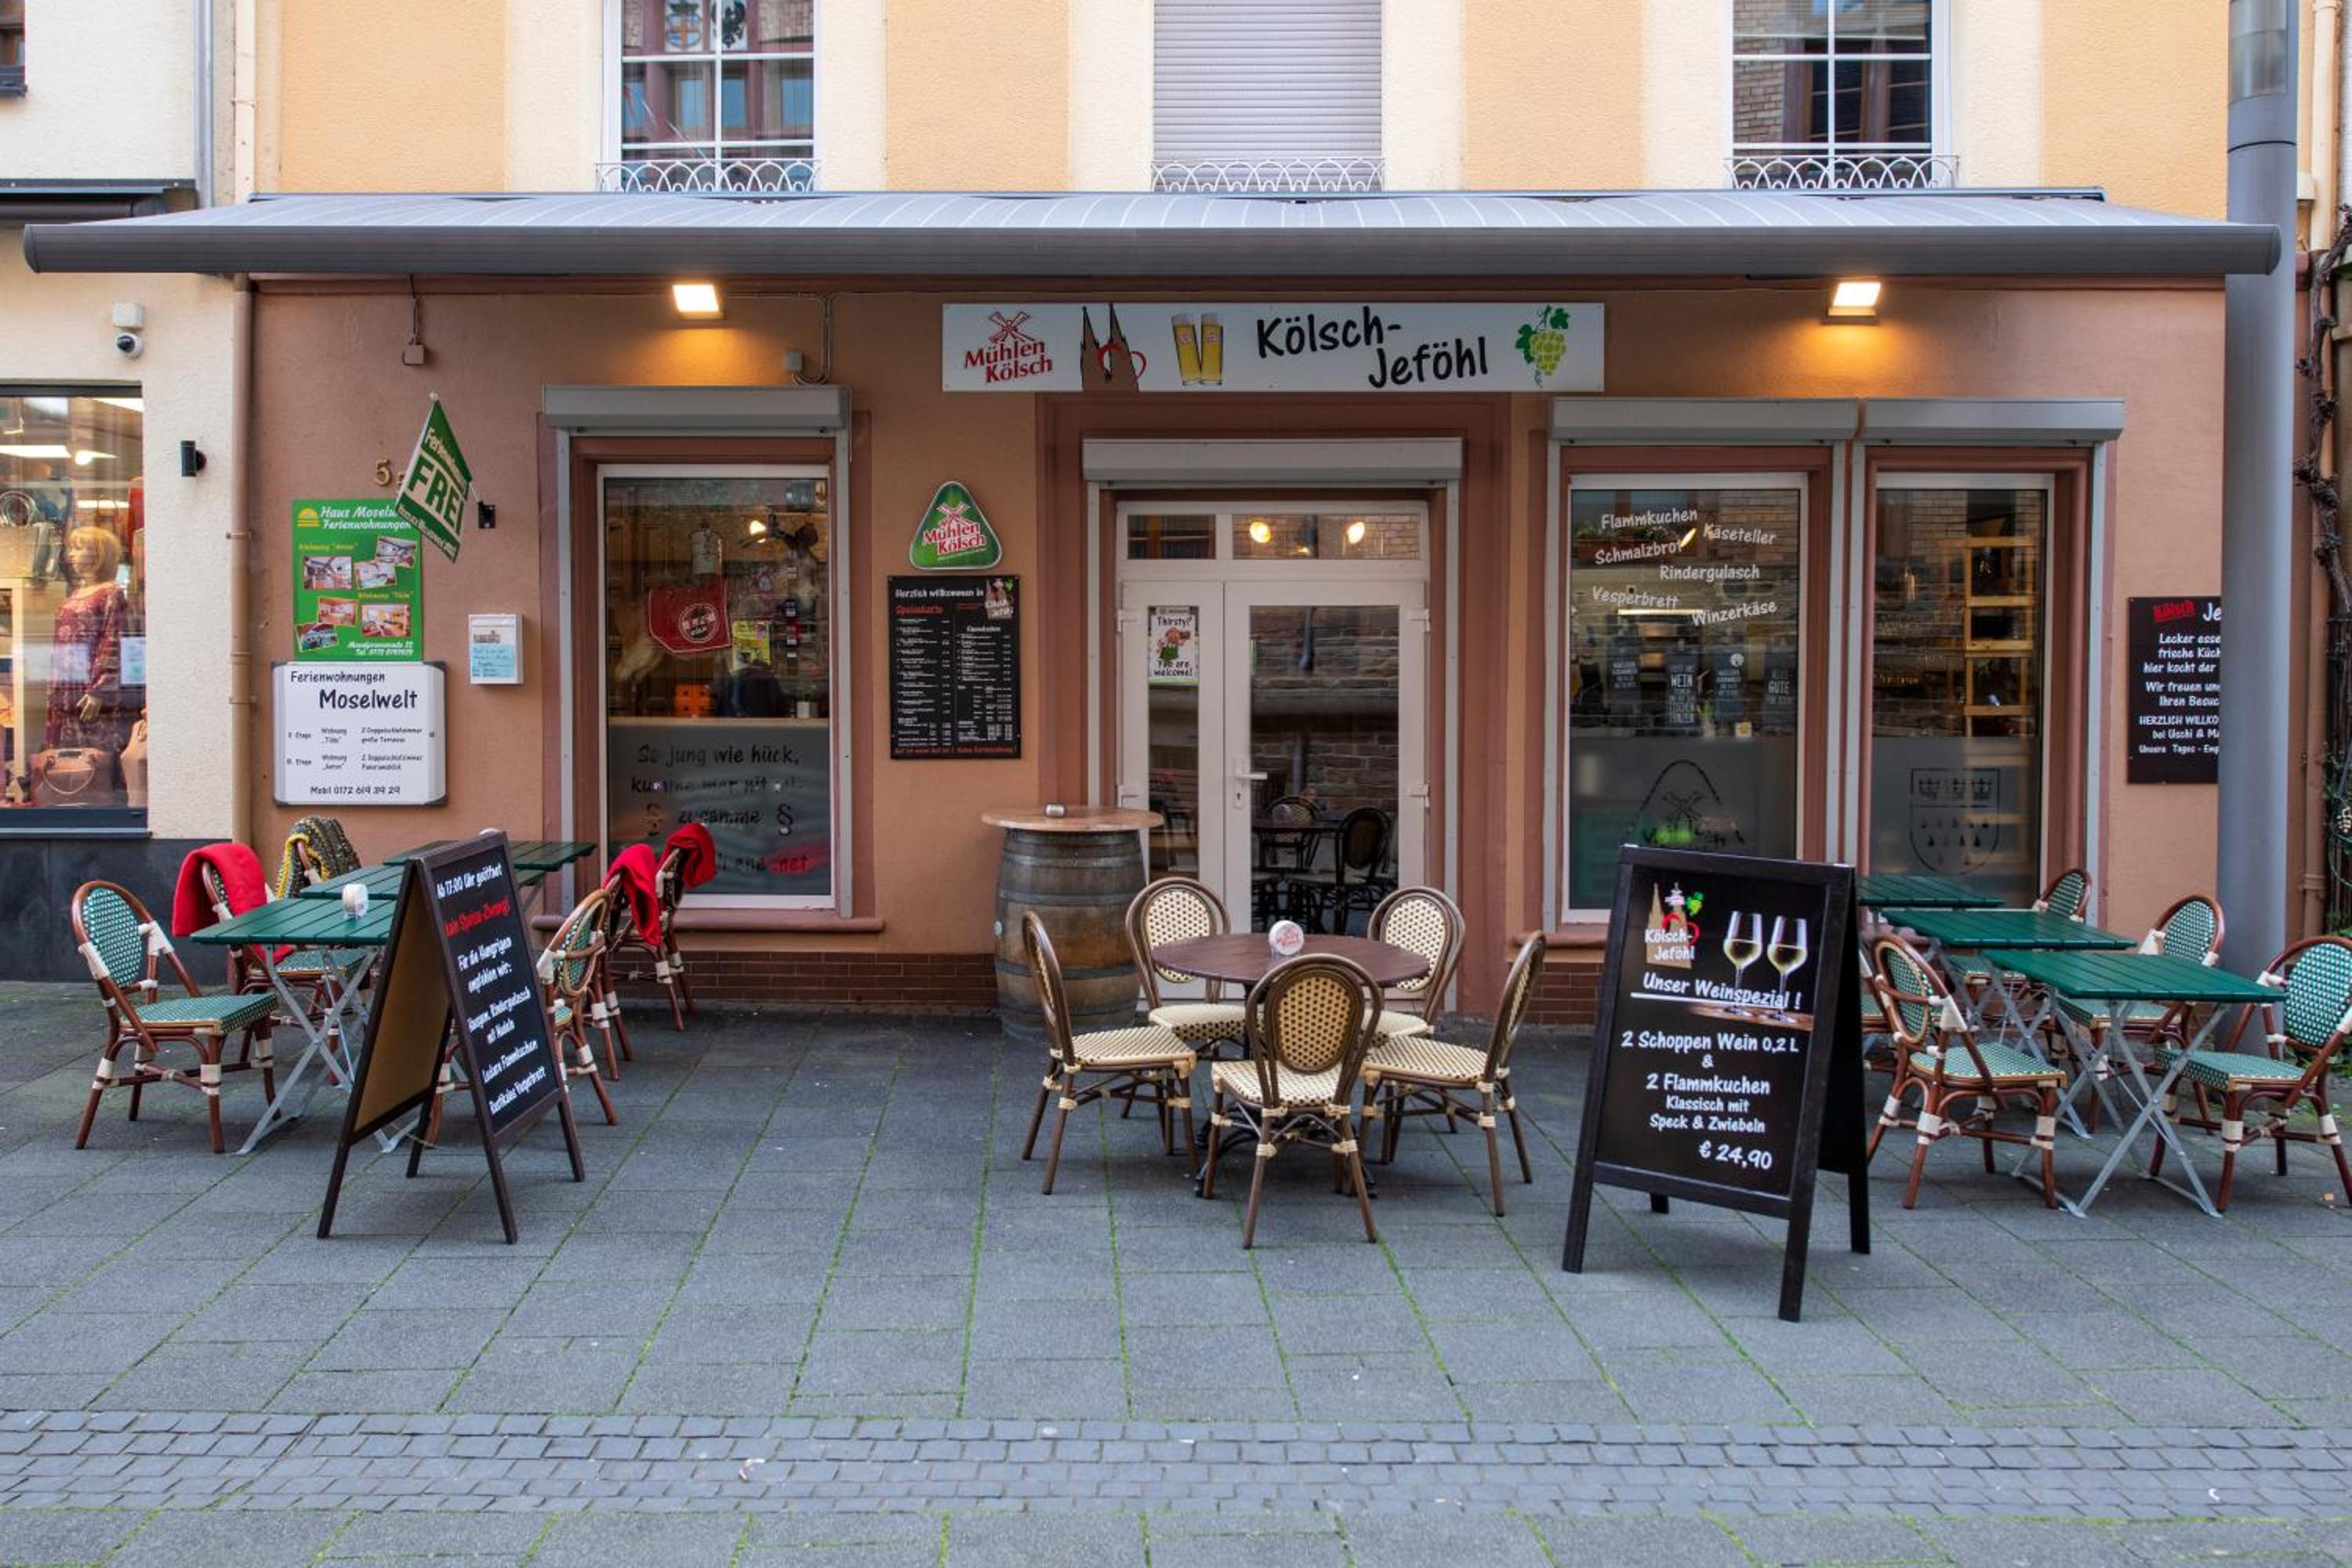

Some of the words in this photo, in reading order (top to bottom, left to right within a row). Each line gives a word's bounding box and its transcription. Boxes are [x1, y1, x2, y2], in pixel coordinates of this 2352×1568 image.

[1256, 306, 1401, 359] Kölsch-
[963, 340, 1045, 370] Mühlen
[1368, 336, 1489, 390] Jeföhl
[984, 357, 1053, 383] Kölsch
[376, 459, 390, 486] 5
[321, 506, 350, 518] Haus
[1602, 508, 1697, 529] Flammkuchen
[323, 519, 412, 532] Ferienwohnungen
[924, 524, 979, 543] Mühlen
[1703, 523, 1777, 545] Käseteller
[938, 534, 985, 553] Kölsch
[1595, 539, 1682, 564] Schmalzbrot
[1660, 564, 1760, 583] Rindergulasch
[895, 590, 927, 598] Herzlich
[977, 588, 984, 597] in
[1592, 586, 1679, 608] Vesperbrett
[1157, 616, 1192, 627] Thirsty?
[1692, 601, 1777, 626] Winzerkäse
[2159, 633, 2194, 644] Lecker
[2158, 648, 2194, 659] frische
[1154, 668, 1192, 677] welcome!
[2143, 662, 2164, 673] hier
[2167, 662, 2195, 673] kocht
[2198, 662, 2216, 673] der
[291, 671, 385, 684] Ferienwohnungen
[2146, 682, 2165, 692] Wir
[2168, 681, 2202, 692] freuen
[319, 689, 417, 710] Moselwelt
[2159, 696, 2185, 706] Ihren
[2139, 716, 2183, 725] HERZLICH
[2152, 730, 2165, 739] bei
[2168, 729, 2193, 739] Uschi
[2196, 729, 2205, 738] &
[666, 745, 706, 767] jung
[715, 745, 744, 764] wie
[2172, 744, 2195, 755] Tages
[437, 882, 445, 899] Ab
[445, 876, 463, 895] 17:00
[463, 873, 475, 888] Uhr
[476, 862, 503, 887] geöffnet
[1645, 927, 1693, 943] Kölsch-
[1654, 946, 1694, 961] Jeföhl
[1643, 972, 1690, 993] Unser
[1695, 978, 1788, 1008] Weinspezial
[489, 985, 531, 1018] Rindergulasch
[1621, 1031, 1633, 1047] 2
[1638, 1031, 1711, 1053] Schoppen
[1717, 1032, 1757, 1051] Wein
[1762, 1036, 1786, 1053] 0,2
[1790, 1036, 1798, 1053] L
[500, 1040, 539, 1069] Flammkuchen
[1701, 1054, 1713, 1069] &
[1646, 1073, 1658, 1090] 2
[1664, 1073, 1770, 1094] Flammkuchen
[1666, 1095, 1724, 1112] Klassisch
[1728, 1098, 1749, 1113] mit
[1650, 1113, 1687, 1131] Speck
[1692, 1115, 1704, 1130] &
[1708, 1116, 1766, 1133] Zwiebeln
[1698, 1140, 1711, 1159] €
[1715, 1143, 1773, 1170] 24,90
